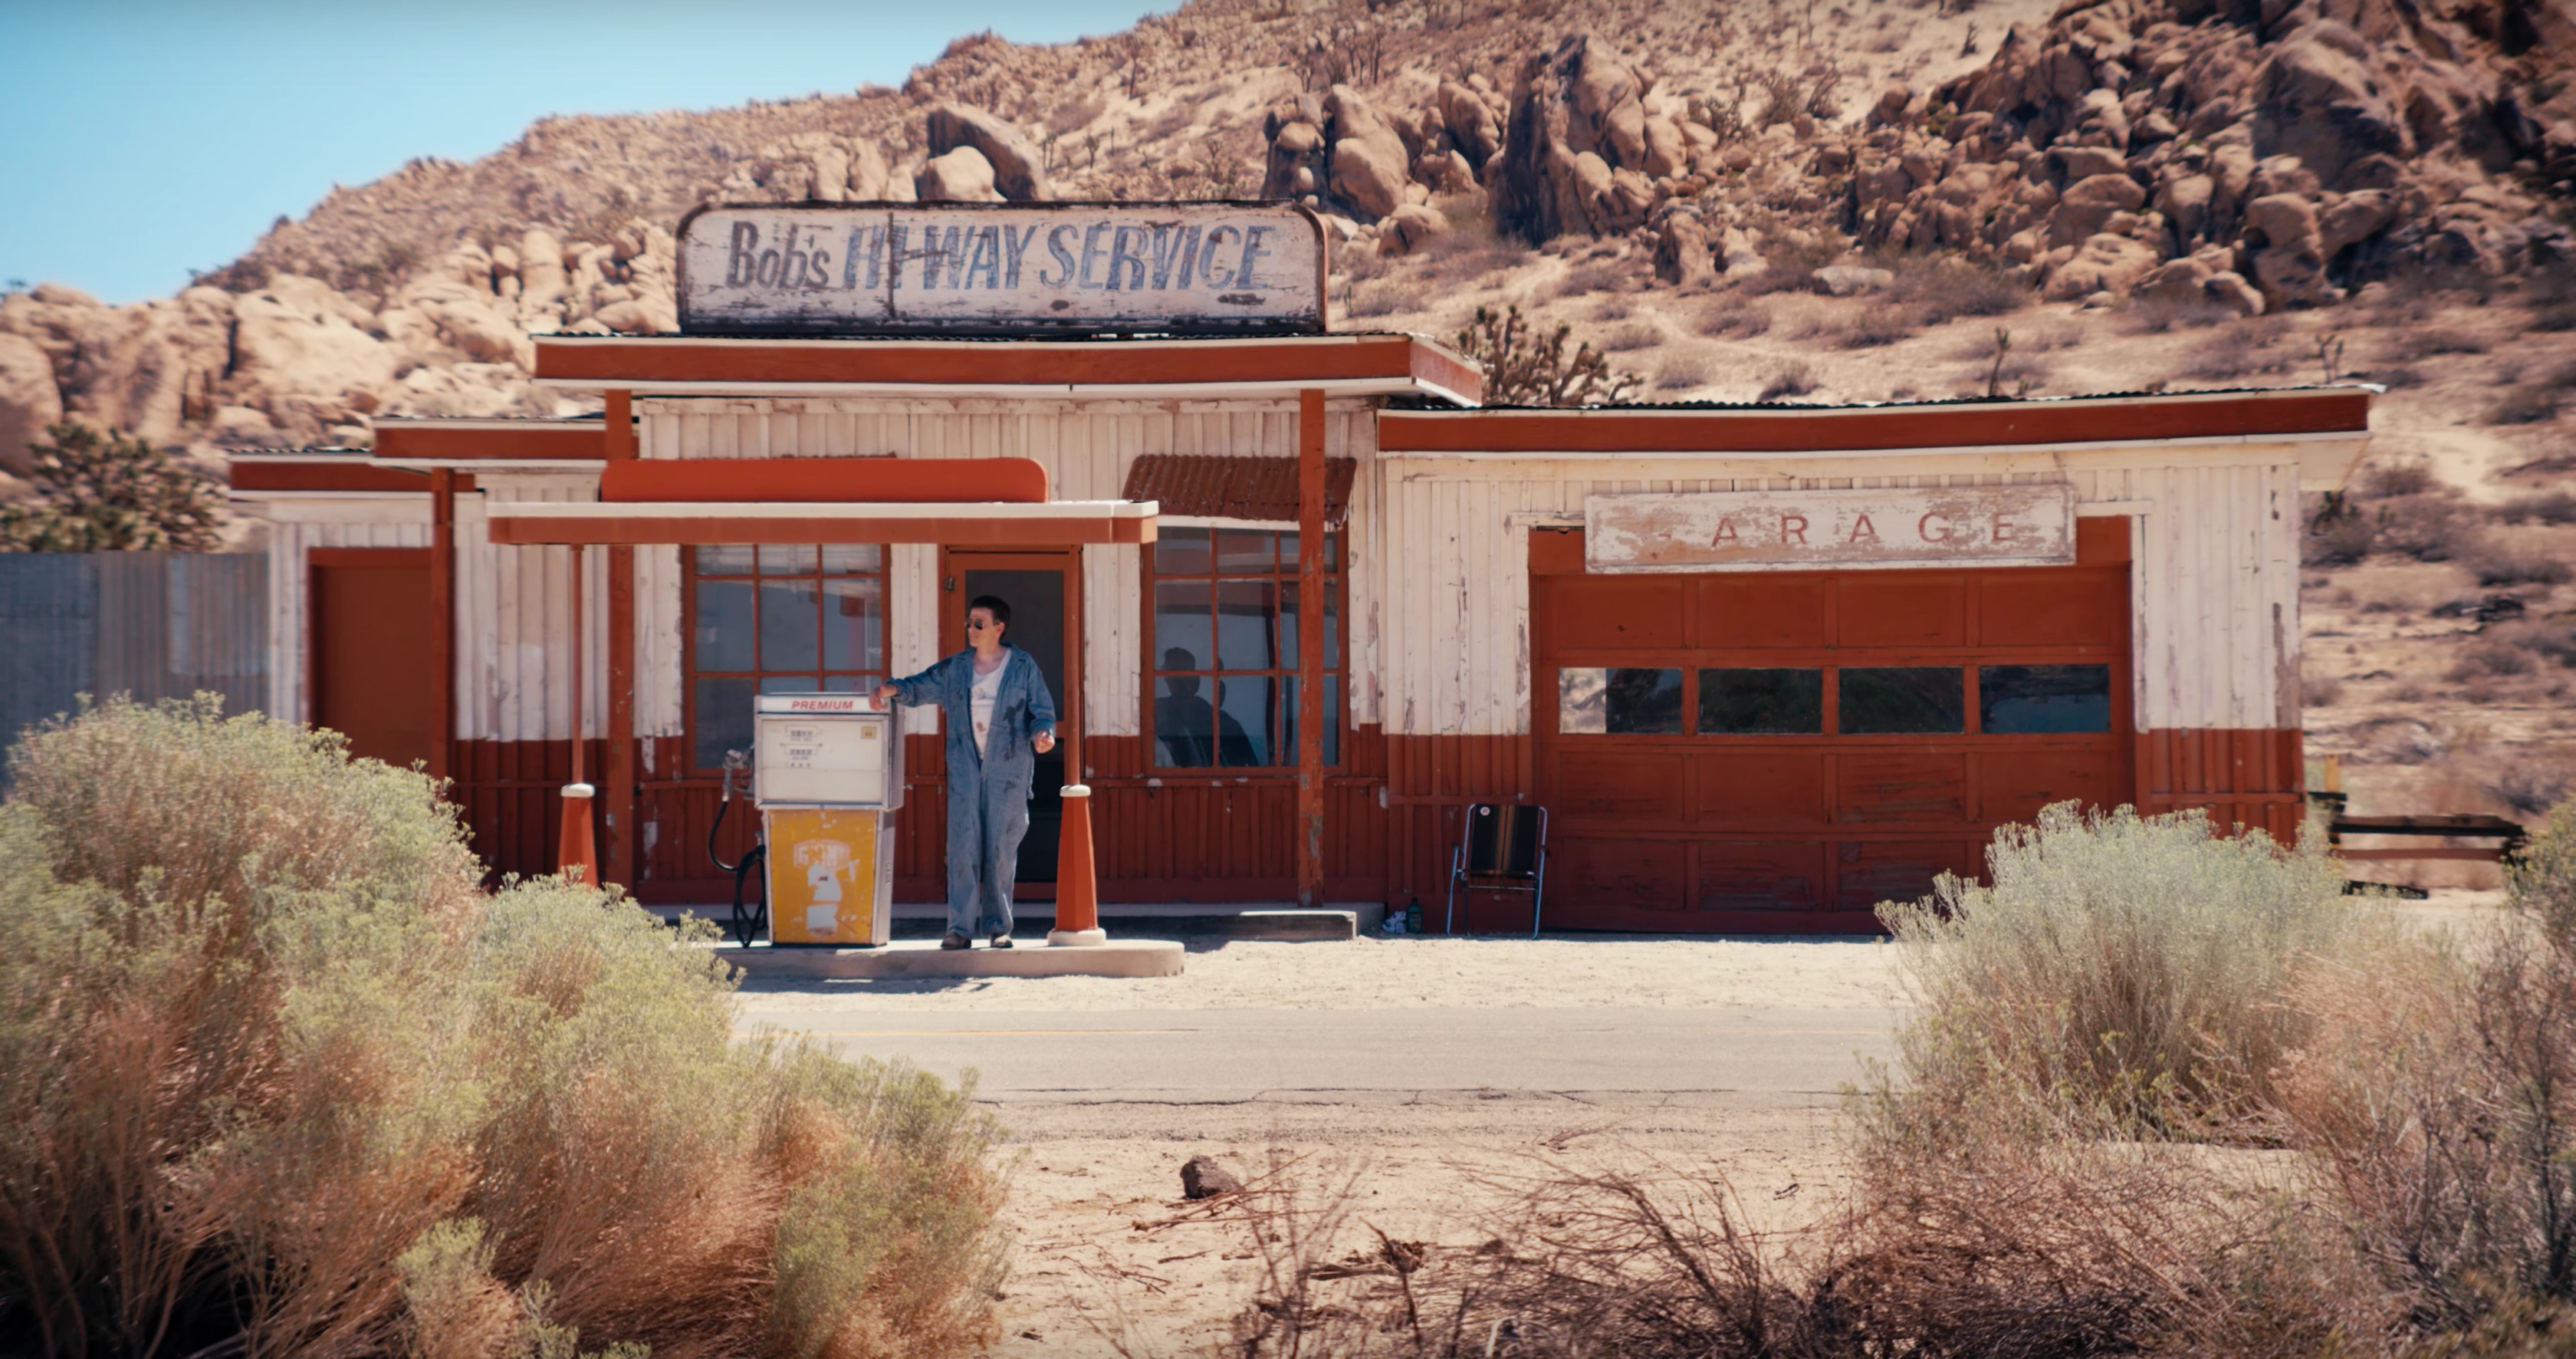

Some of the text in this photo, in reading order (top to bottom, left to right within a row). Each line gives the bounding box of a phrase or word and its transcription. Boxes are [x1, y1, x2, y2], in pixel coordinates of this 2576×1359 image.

[724, 220, 830, 290] Bob's
[1039, 223, 1276, 291] SERVICE
[1648, 512, 2019, 548] ARAGE
[791, 700, 853, 710] PREMIUM
